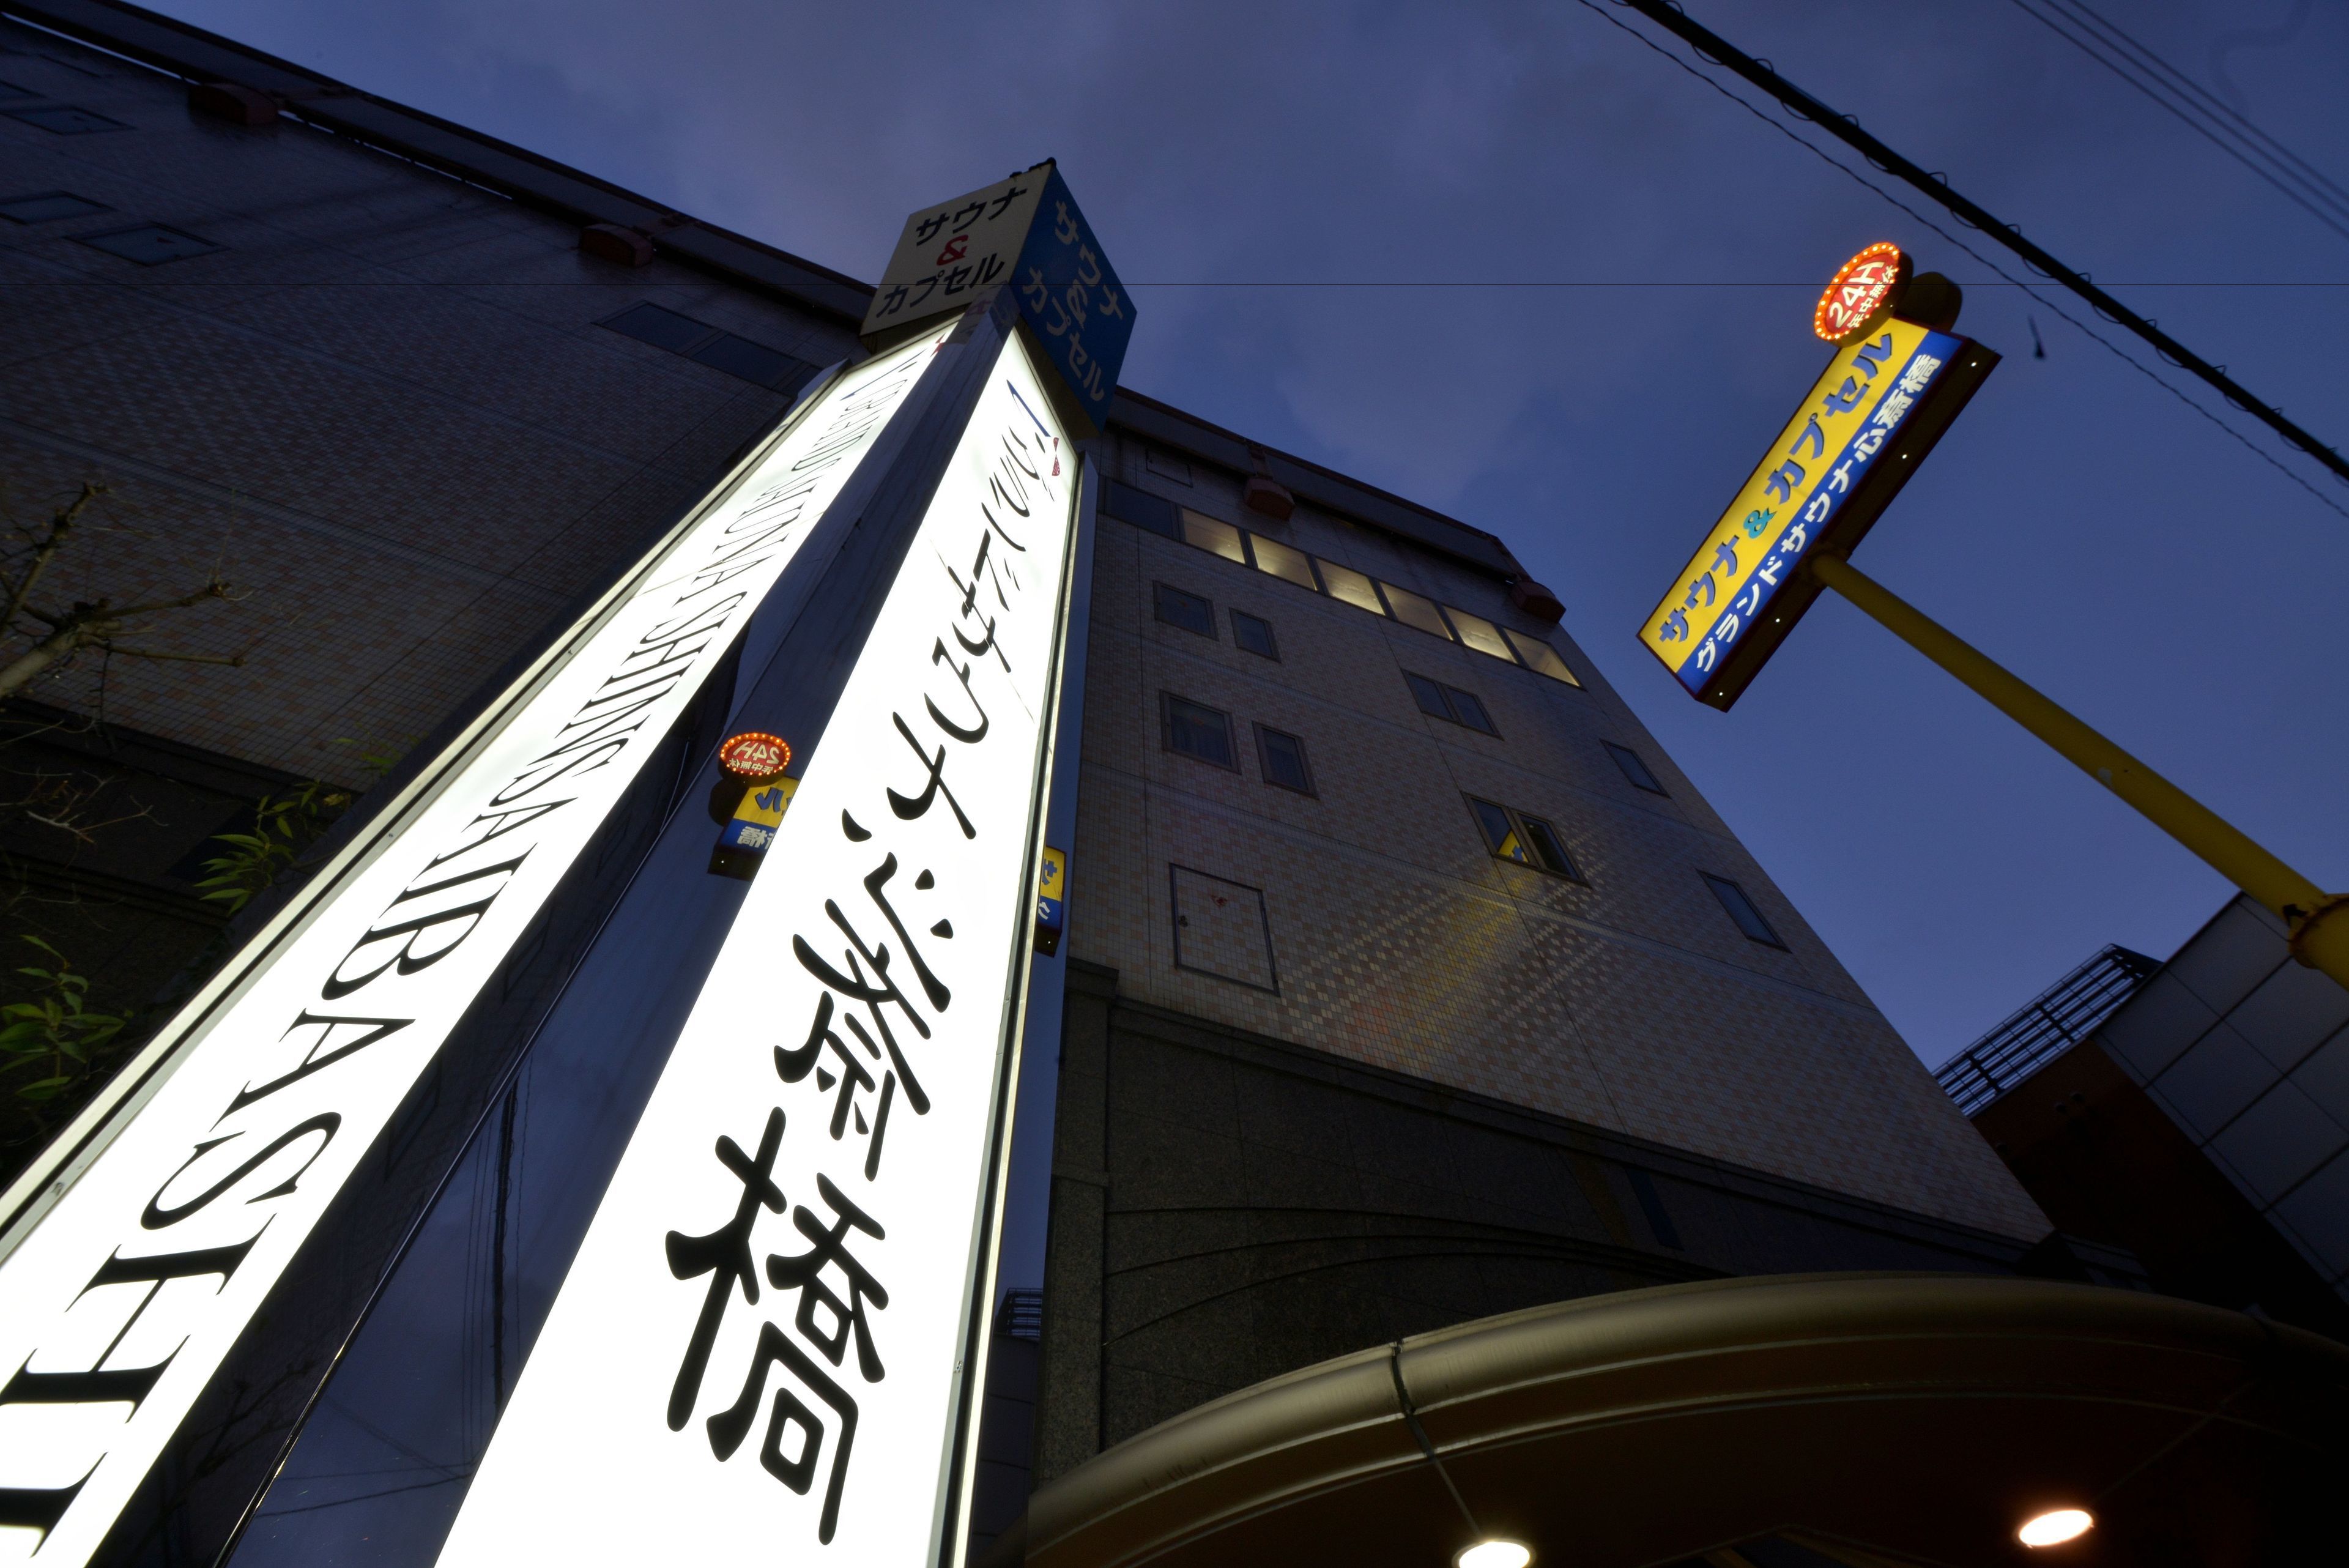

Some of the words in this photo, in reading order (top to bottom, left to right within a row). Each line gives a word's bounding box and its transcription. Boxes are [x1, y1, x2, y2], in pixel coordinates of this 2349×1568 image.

[915, 187, 1028, 247] サウナ
[937, 235, 969, 266] &
[1055, 200, 1123, 319] サウナ
[875, 253, 1005, 318] カプセル
[1066, 280, 1088, 329] &
[1829, 262, 1885, 328] 24H
[1847, 265, 1895, 328] 年中無休
[1022, 266, 1105, 401] カプセル
[792, 379, 908, 472] GRAND
[672, 457, 842, 608] SAUNA
[1696, 354, 1941, 672] グランドサウナ心斎橋
[666, 425, 1055, 1545] グランドサウナ心斎橋
[0, 591, 747, 1558] SHINSAIBASHI
